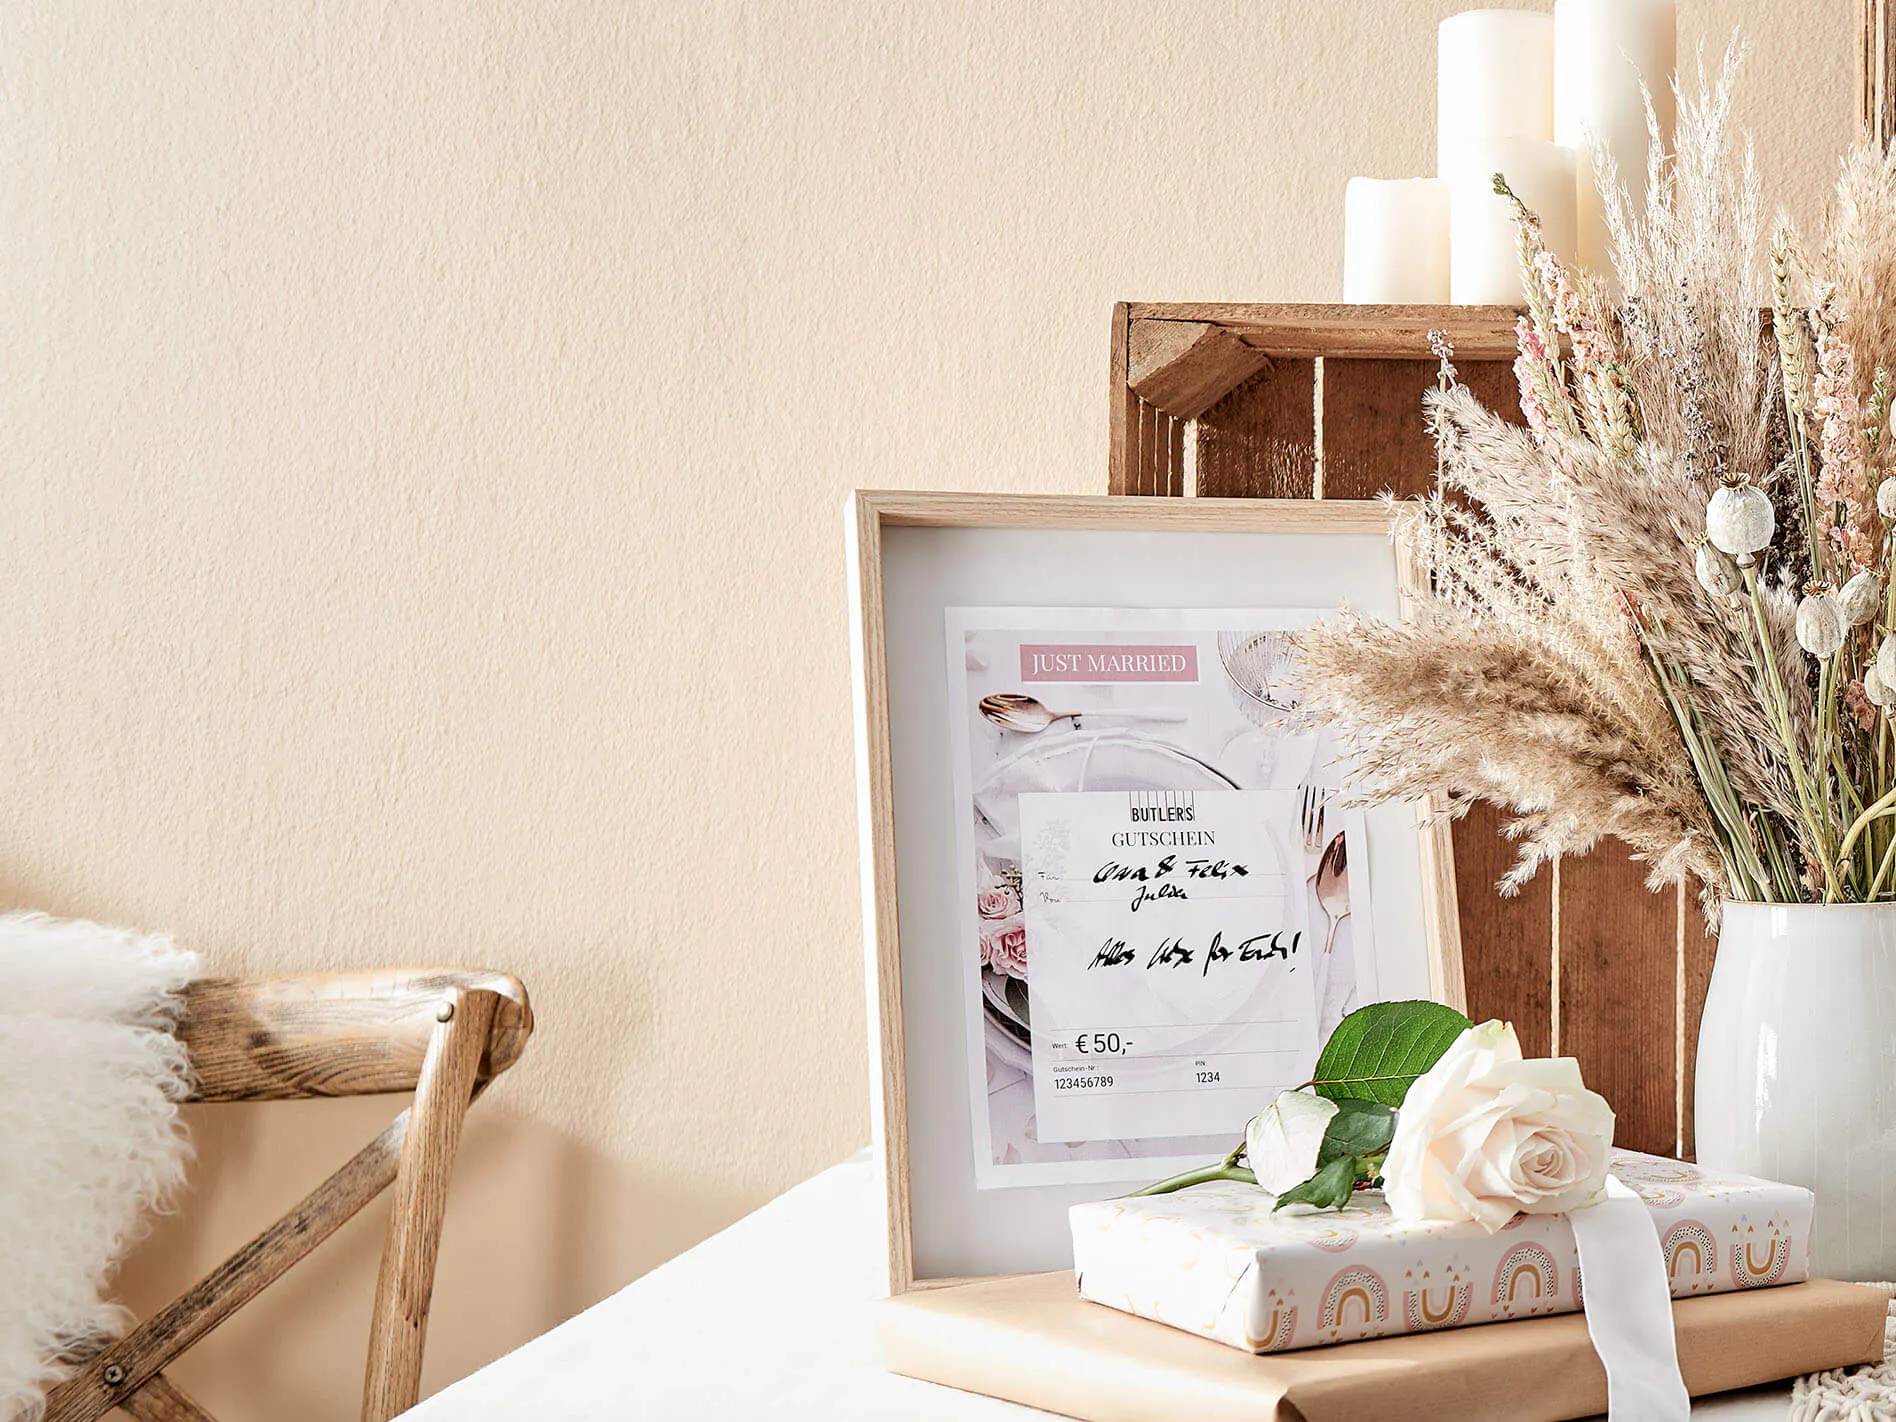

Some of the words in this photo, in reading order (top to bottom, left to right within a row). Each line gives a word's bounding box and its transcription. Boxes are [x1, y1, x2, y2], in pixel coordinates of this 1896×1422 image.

[1032, 653, 1082, 676] JUST
[1087, 653, 1187, 673] MARRIED
[1131, 806, 1194, 822] BUTLERS
[1111, 830, 1215, 847] GUTSCHEIN
[1075, 1034, 1089, 1054] €
[1093, 1033, 1134, 1056] 50,-
[1054, 1076, 1114, 1090] 123456789
[1196, 1072, 1221, 1083] 1234
